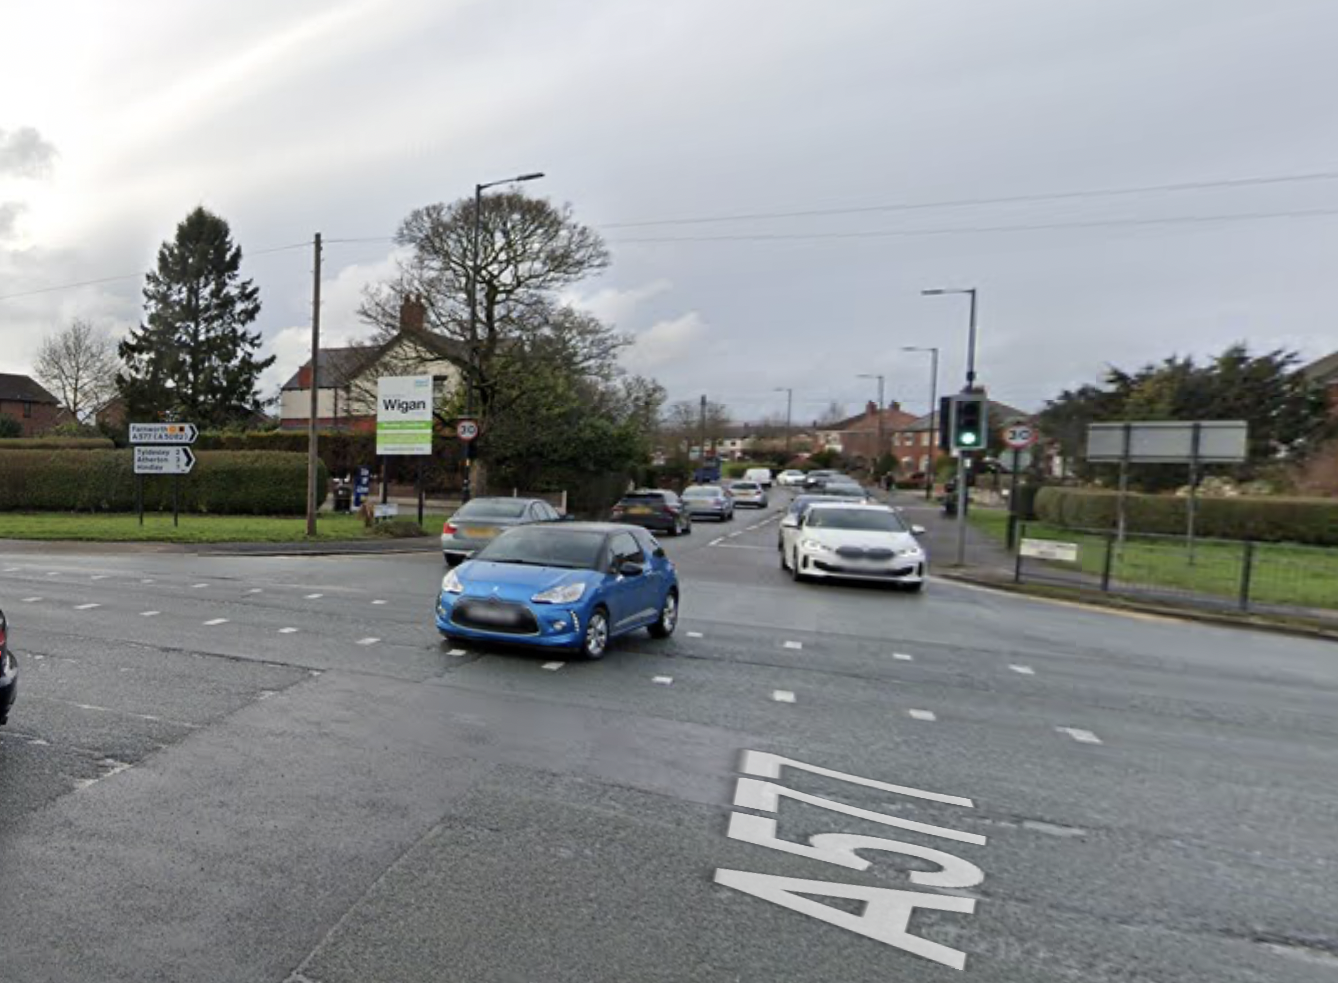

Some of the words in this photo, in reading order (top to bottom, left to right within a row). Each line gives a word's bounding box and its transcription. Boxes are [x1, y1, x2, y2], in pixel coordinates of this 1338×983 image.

[382, 399, 426, 414] Wigan
[461, 425, 477, 435] 30
[1008, 429, 1032, 440] 30
